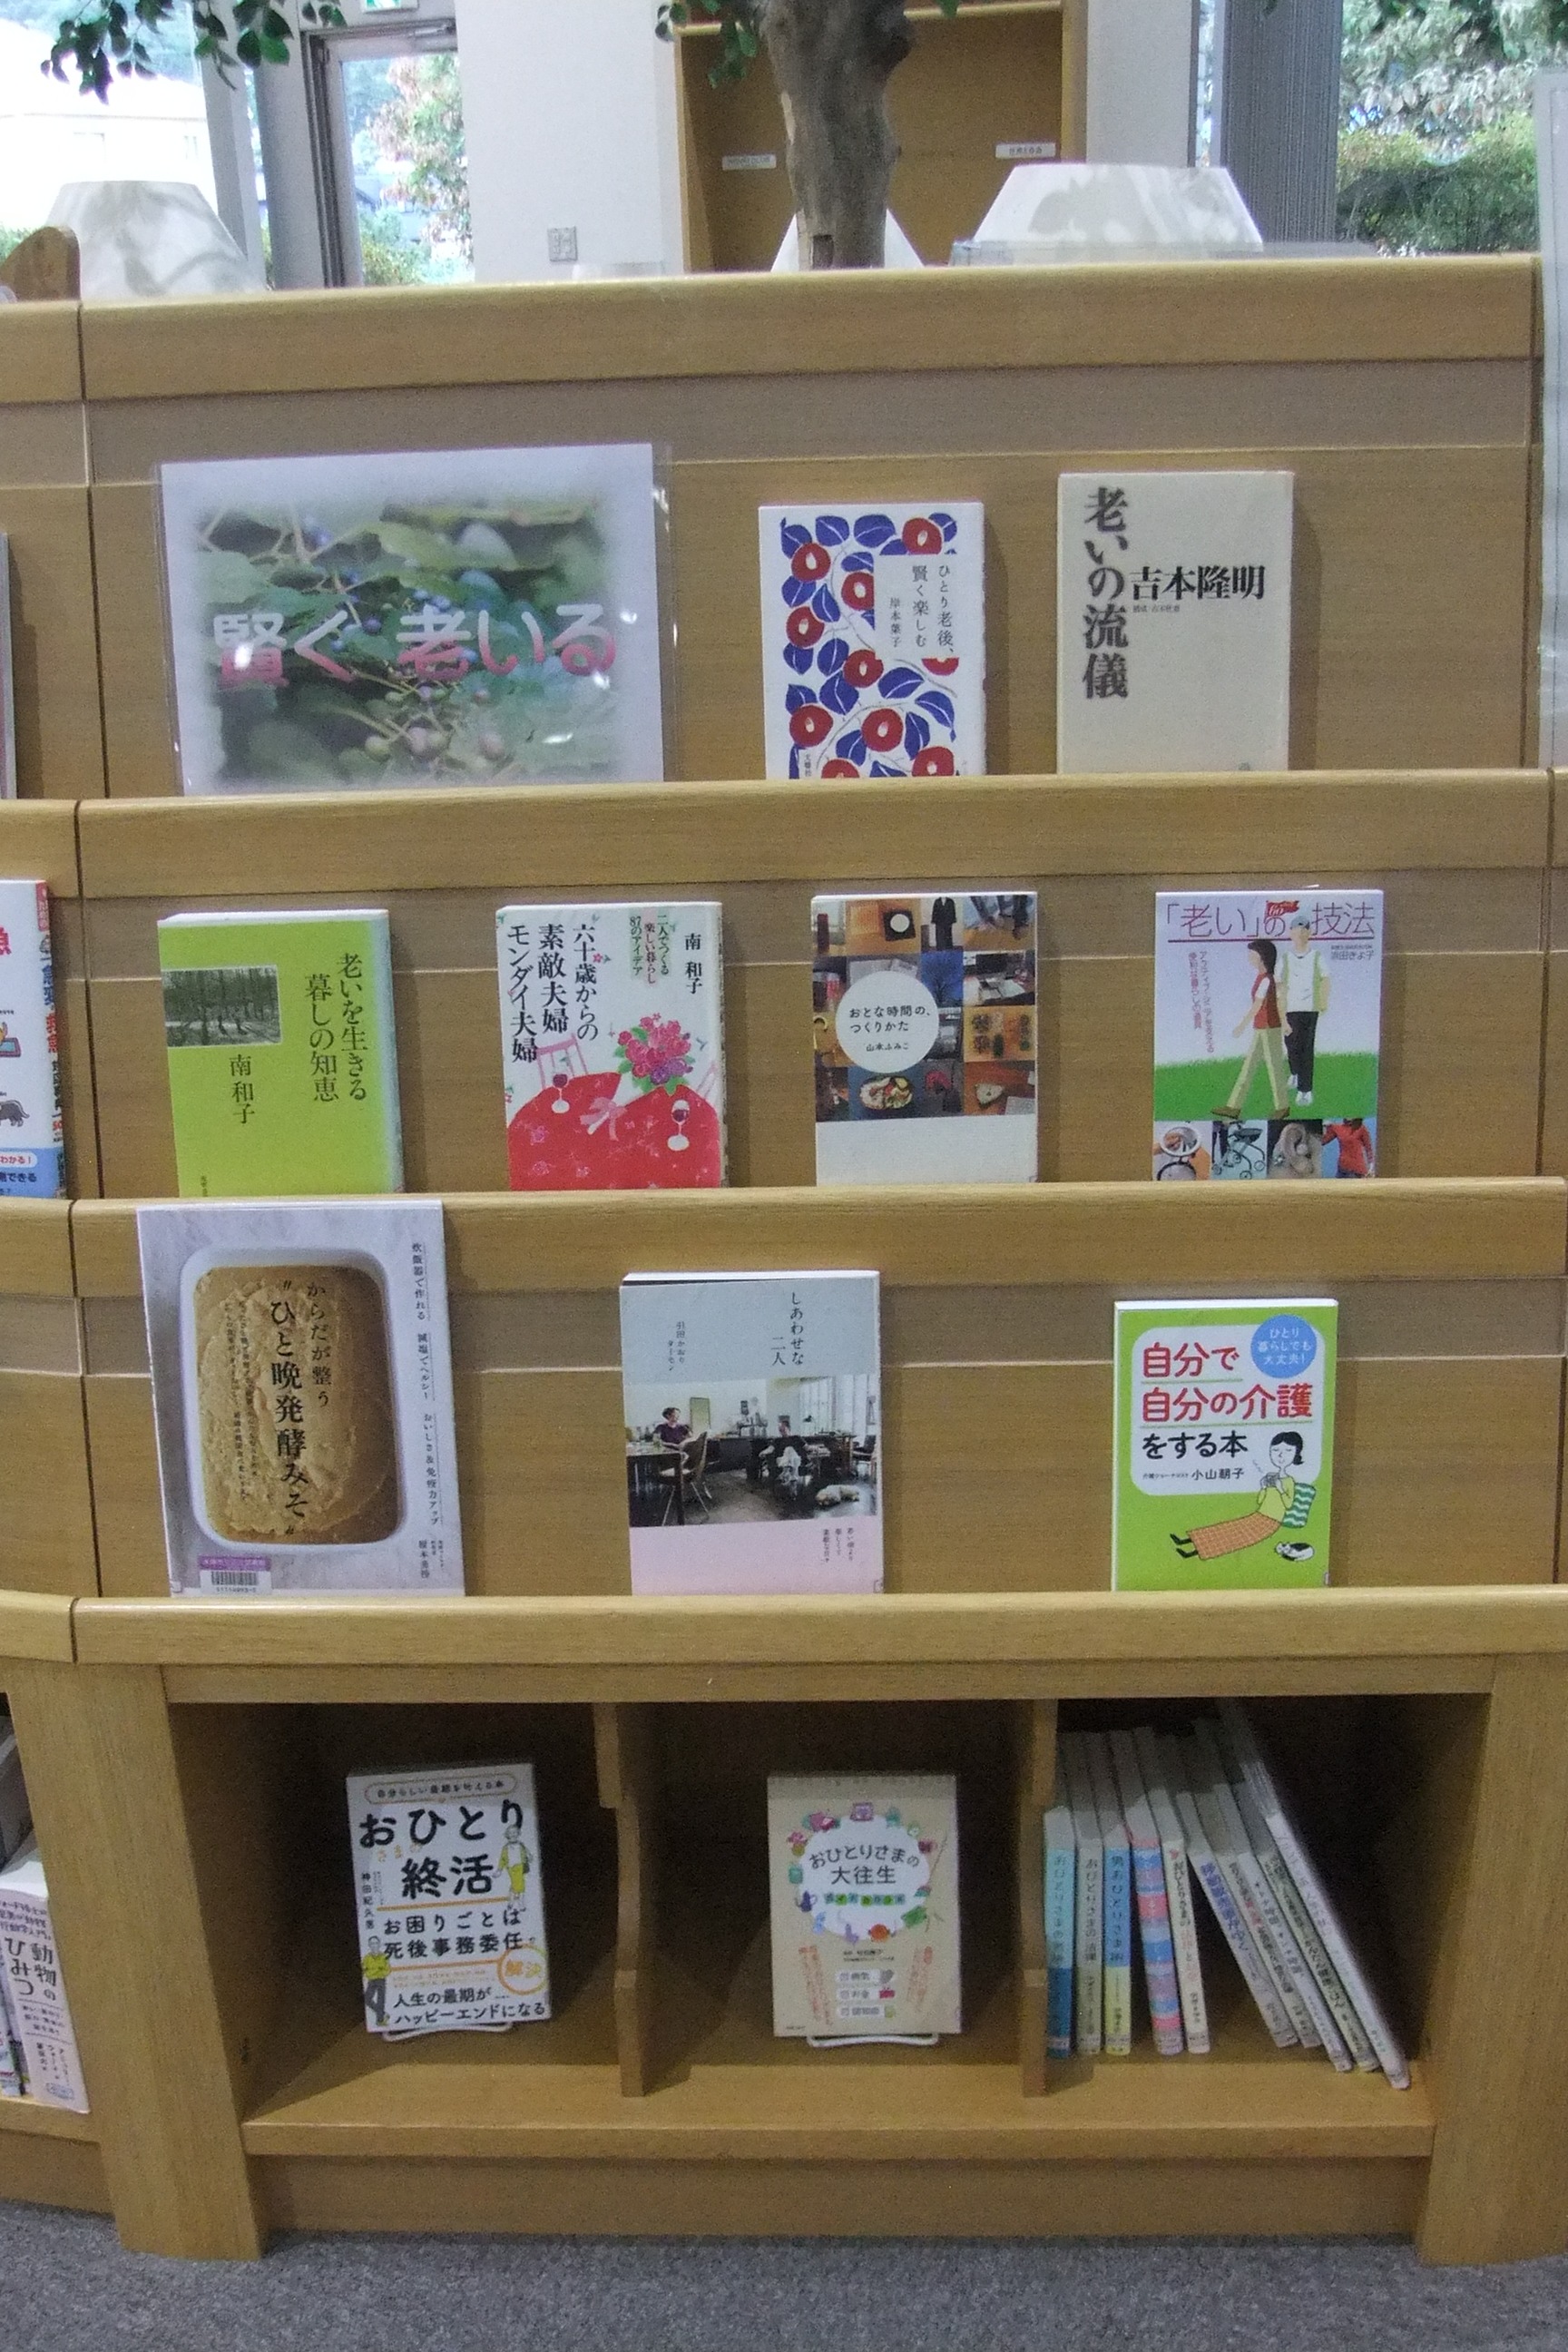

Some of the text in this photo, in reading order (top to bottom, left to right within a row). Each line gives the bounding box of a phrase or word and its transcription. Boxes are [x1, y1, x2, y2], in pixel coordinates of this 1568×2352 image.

[912, 565, 929, 648] 賢く楽しむ
[1083, 486, 1129, 699] 老いの流儀
[1130, 565, 1266, 600] 吉本隆明
[889, 597, 902, 648] 岸本葉子
[644, 923, 656, 984] 楽しい暮らし
[657, 915, 670, 975] 二人でつくる
[684, 934, 703, 995] 南 和子
[507, 924, 538, 1063] モンダイ夫婦
[538, 924, 568, 1034] 素敵夫婦
[573, 924, 599, 1042] 六十歳からの
[305, 974, 338, 1102] 暮しの知恵
[337, 953, 368, 1102] 老いを生きる
[850, 1020, 909, 1034] つくりかた
[866, 1043, 909, 1053] 山本ふみこ
[230, 1054, 256, 1124] 南和子
[307, 1281, 333, 1408] からだが整う
[771, 1337, 786, 1367] 二人
[790, 1292, 804, 1366] しあわせな
[1258, 1340, 1312, 1353] 暮らしでも
[1269, 1327, 1299, 1338] ひとり
[1142, 1342, 1240, 1378] 自分で
[1142, 1384, 1313, 1423] 自分の介護
[1142, 1430, 1248, 1459] をする本
[1191, 1468, 1245, 1482] 小山朝子
[359, 1799, 524, 1848] おひとり
[402, 1854, 495, 1899] 終活
[809, 1844, 920, 1870] おひとりさまの
[830, 1865, 897, 1886] 大往生
[5, 1936, 34, 1995] ひみつ
[31, 1943, 56, 2001] 動物の
[395, 2002, 544, 2024] ハッピーエンドになる
